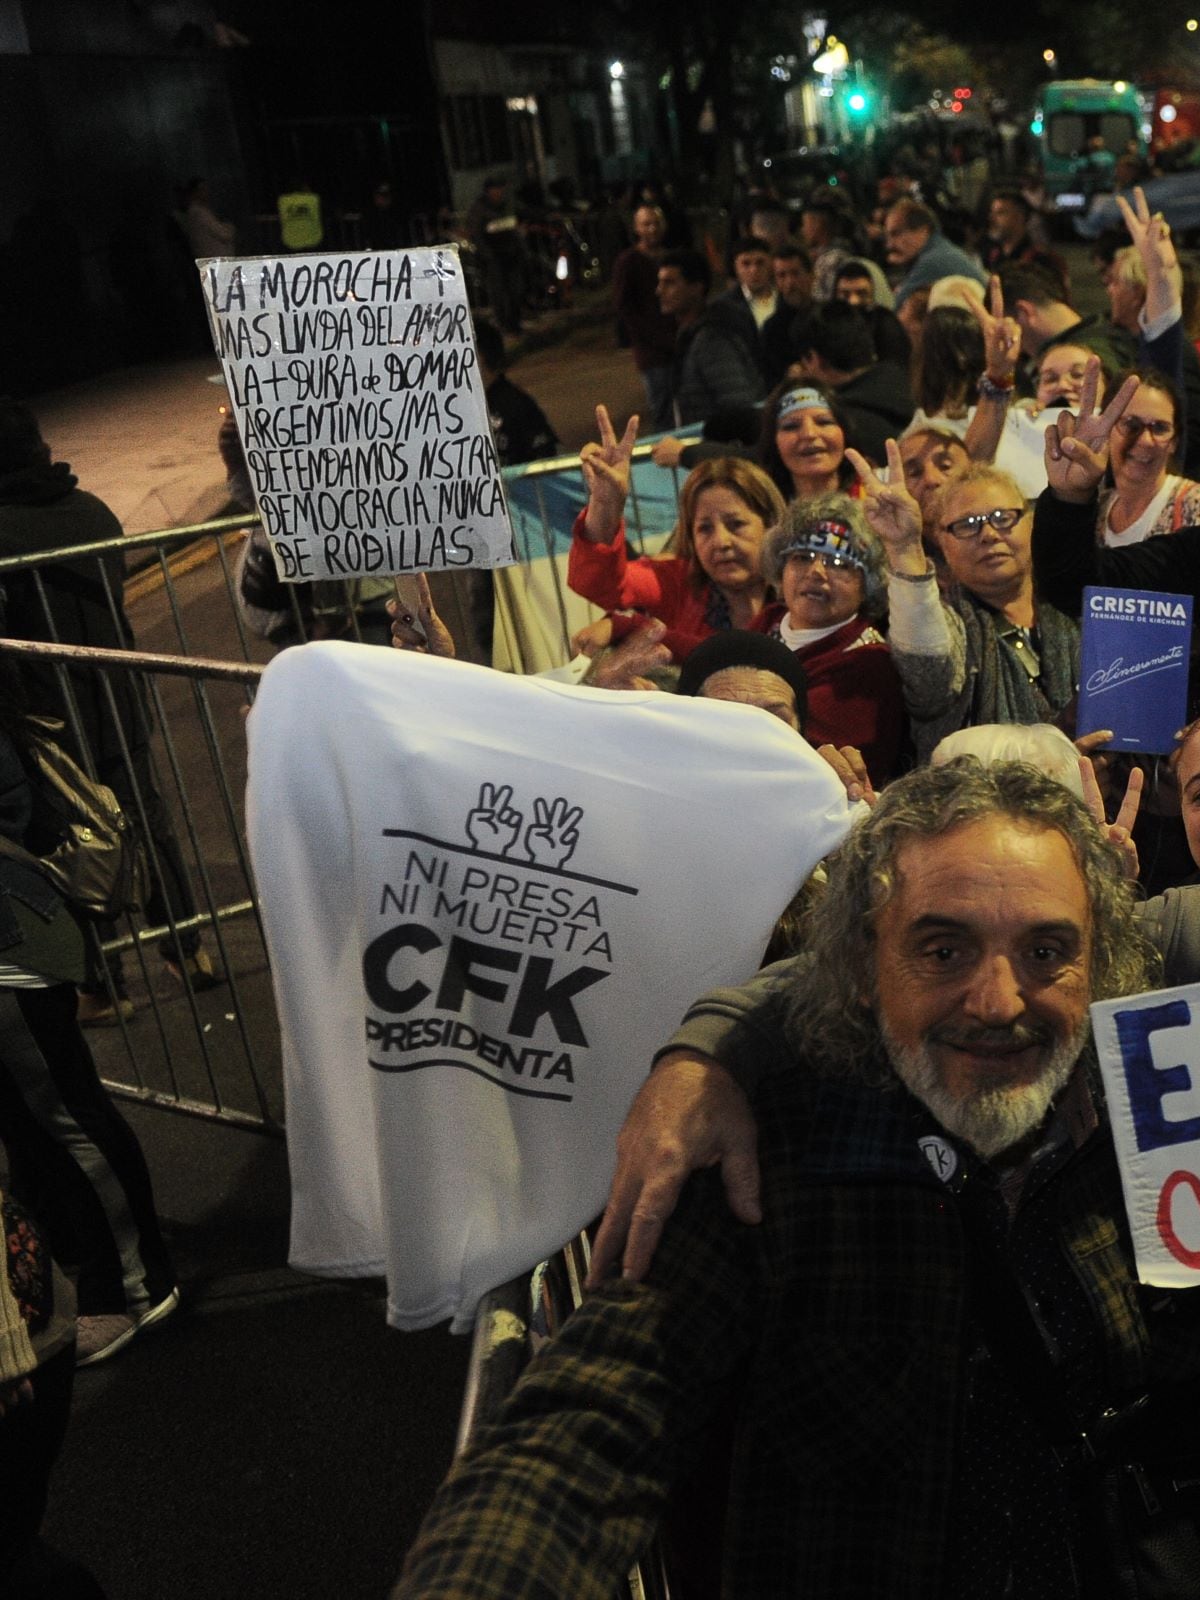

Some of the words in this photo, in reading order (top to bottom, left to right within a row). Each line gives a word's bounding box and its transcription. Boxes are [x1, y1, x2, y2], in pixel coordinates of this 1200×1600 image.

[211, 265, 245, 313] LA
[260, 254, 411, 312] MOROCHA
[217, 312, 271, 361] MAS
[289, 353, 358, 401] DURA
[361, 358, 380, 395] de
[384, 347, 474, 393] DOMAR
[248, 442, 408, 493] DEFENDAMOS
[419, 435, 502, 481] NSTRA
[275, 541, 314, 578] DE
[1089, 595, 1187, 619] CRISTINA
[1149, 617, 1186, 626] KIRCHNER
[404, 850, 448, 888] NI
[460, 867, 602, 927] PRESA
[379, 883, 420, 915] NI
[433, 891, 613, 963] MUERTA
[362, 922, 612, 1049] CFK
[365, 1016, 575, 1084] PRESIDENTA
